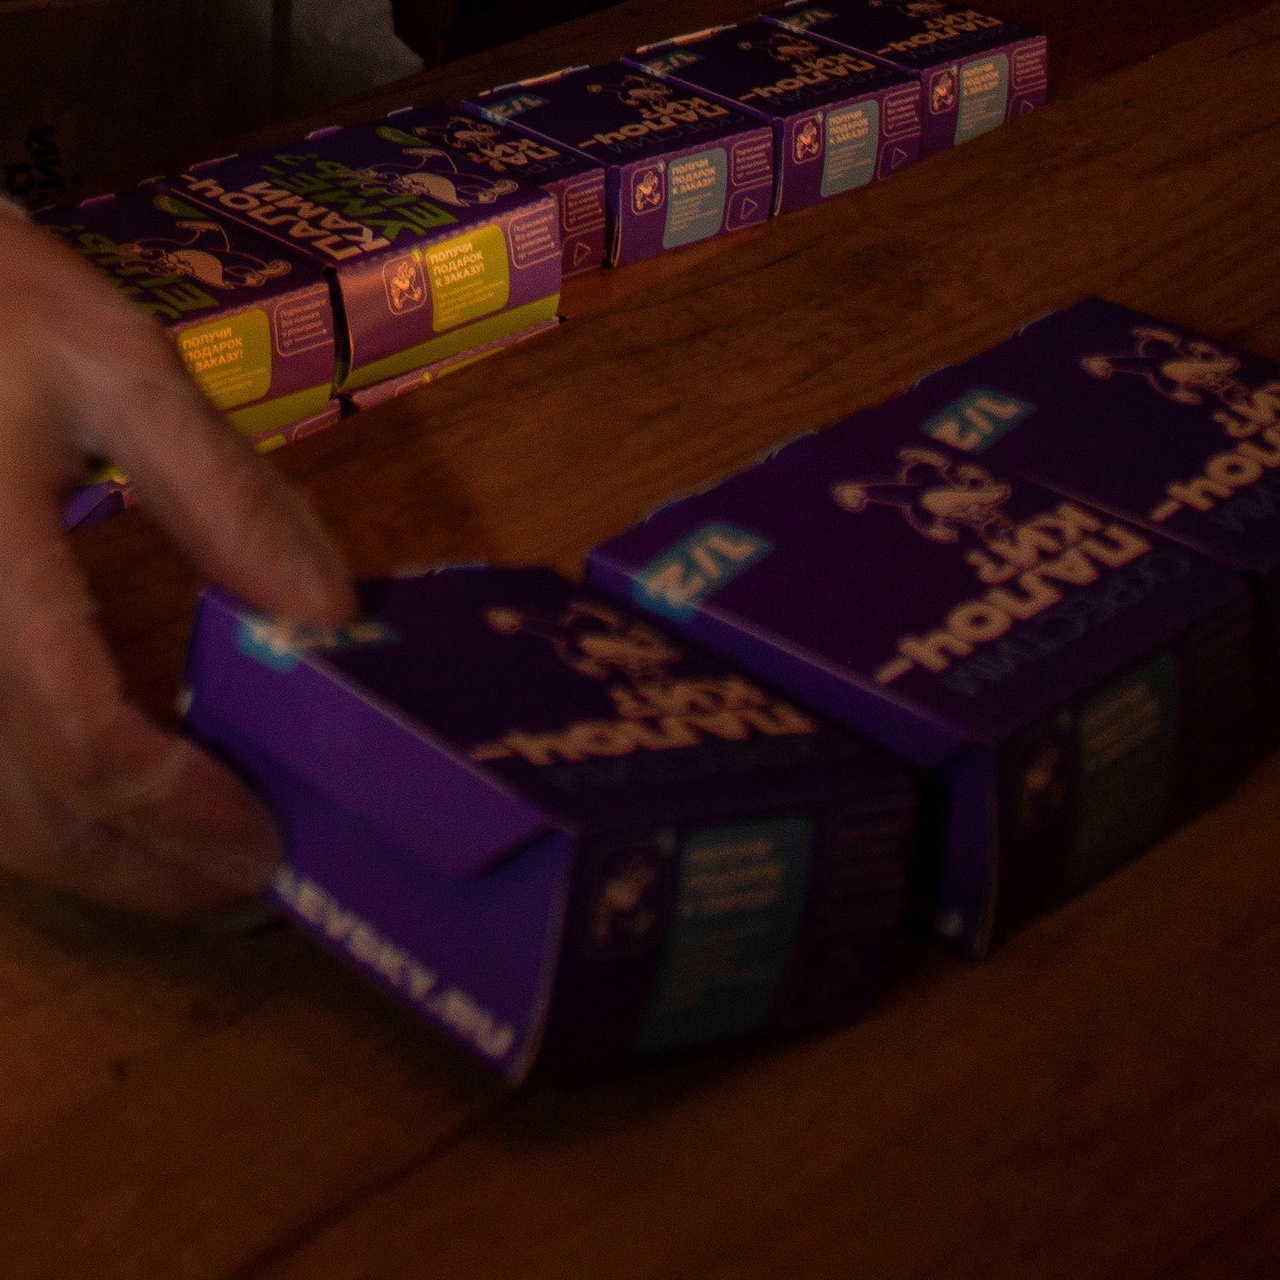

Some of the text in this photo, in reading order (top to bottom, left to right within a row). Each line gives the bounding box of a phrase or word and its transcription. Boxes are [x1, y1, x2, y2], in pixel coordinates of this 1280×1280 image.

[578, 100, 730, 148] ПАЛОЧ-
[180, 173, 365, 261] ПАЛОЧ-
[241, 180, 392, 253] КАМИ
[428, 241, 475, 265] ПОЛУЧИ
[432, 250, 485, 276] ПОДАРОК
[435, 262, 486, 288] К ЗАКАЗУ!
[928, 395, 1023, 453] 1/2
[648, 534, 759, 608] 1/2
[964, 502, 1107, 586] КИ?
[874, 523, 1155, 686] ПАЛОЧ-
